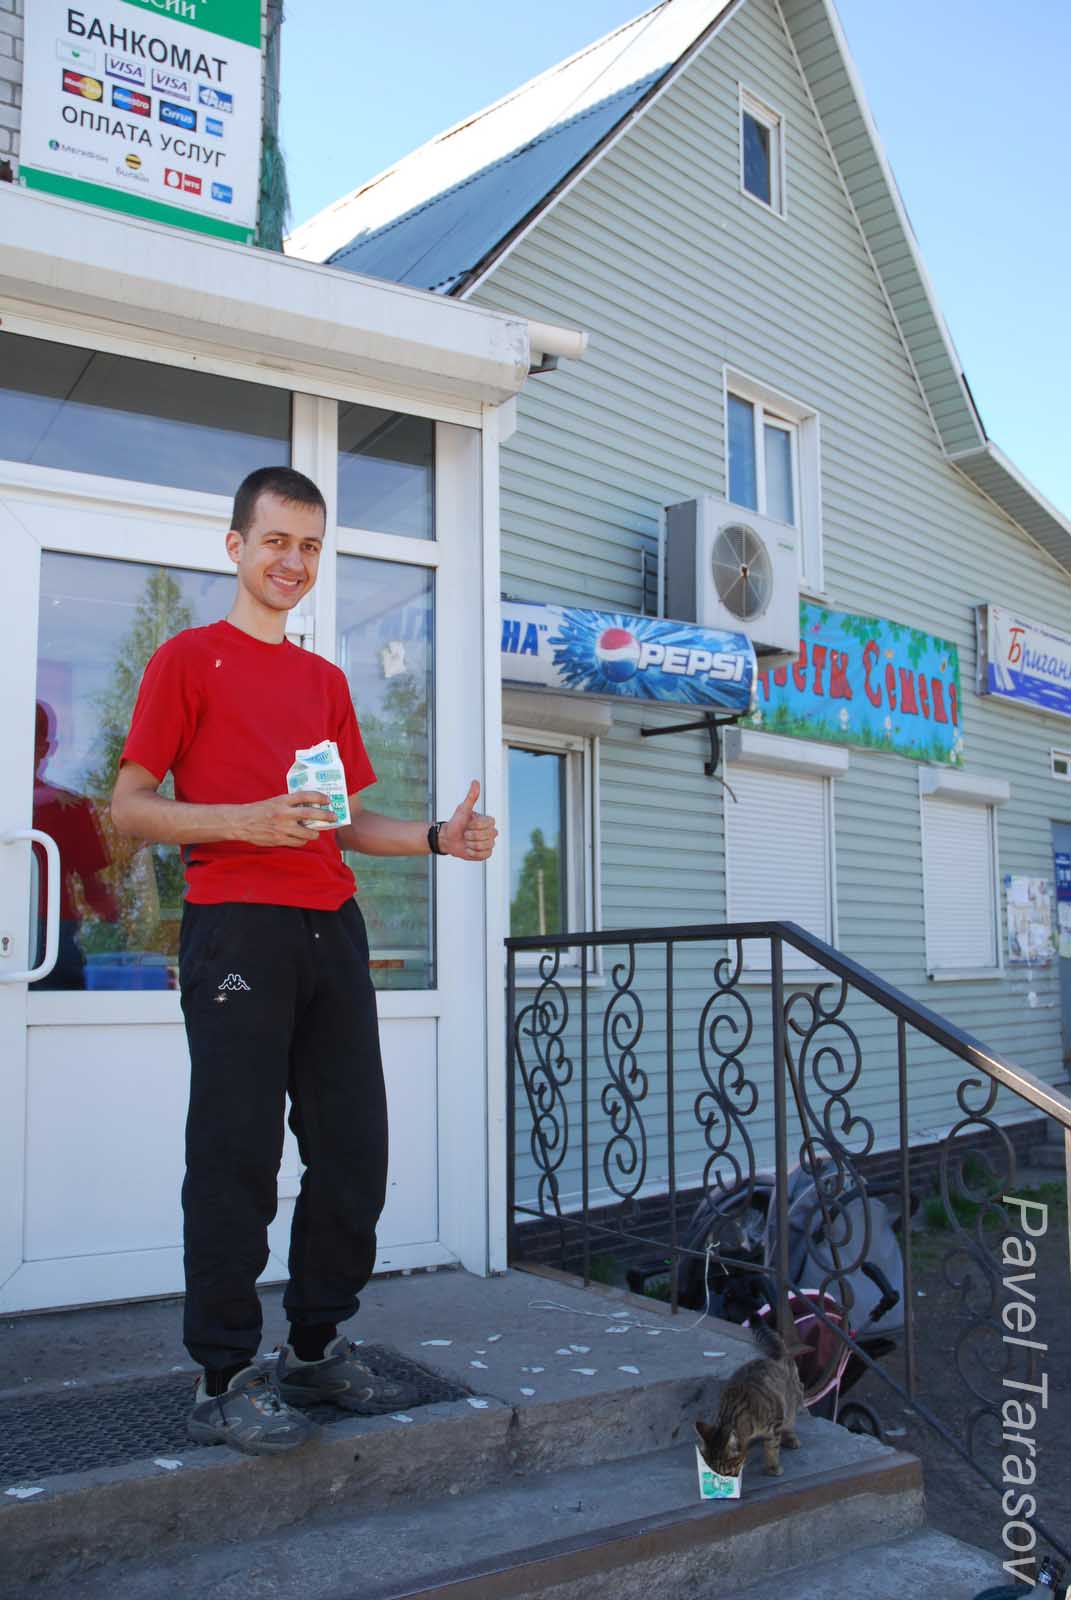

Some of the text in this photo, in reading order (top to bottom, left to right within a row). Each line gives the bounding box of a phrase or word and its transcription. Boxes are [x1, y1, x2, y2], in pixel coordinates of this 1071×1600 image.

[67, 8, 228, 82] БАНКОМАТ
[110, 58, 143, 78] VISA
[157, 72, 188, 92] VISA
[62, 105, 226, 168] ОПЛАТА УСЛУГ
[637, 643, 745, 682] PEPSI
[1006, 626, 1071, 682] Бриган
